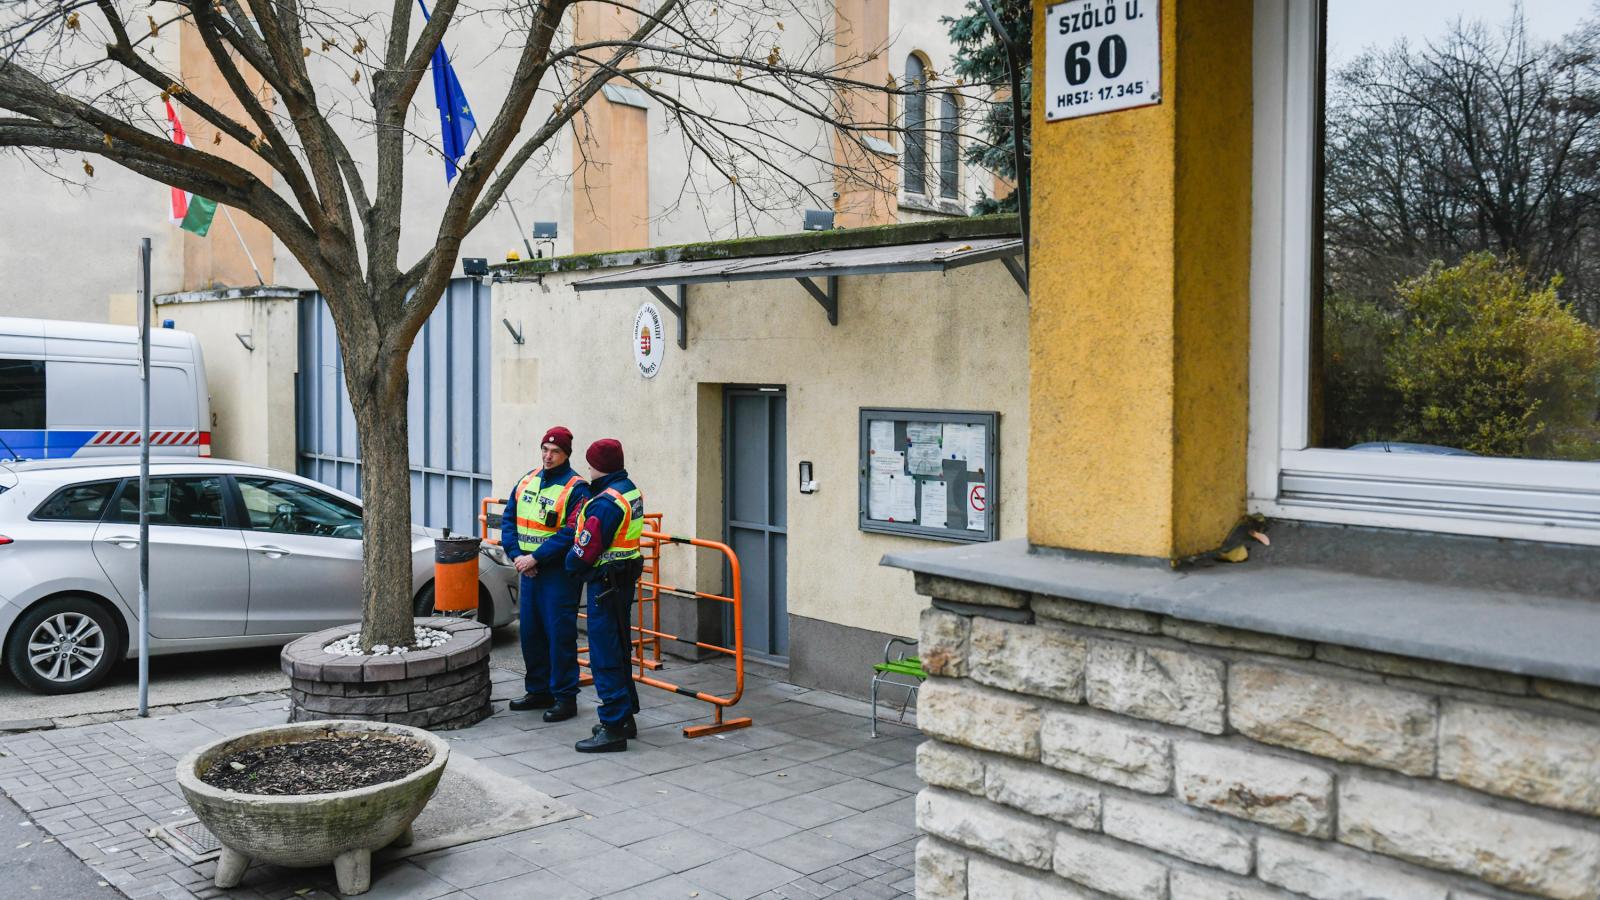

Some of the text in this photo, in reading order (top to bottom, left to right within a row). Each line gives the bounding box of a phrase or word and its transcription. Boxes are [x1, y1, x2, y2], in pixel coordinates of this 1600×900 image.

[1126, 0, 1143, 21] U.
[1064, 34, 1127, 86] 60
[1057, 90, 1094, 108] HRSZ:
